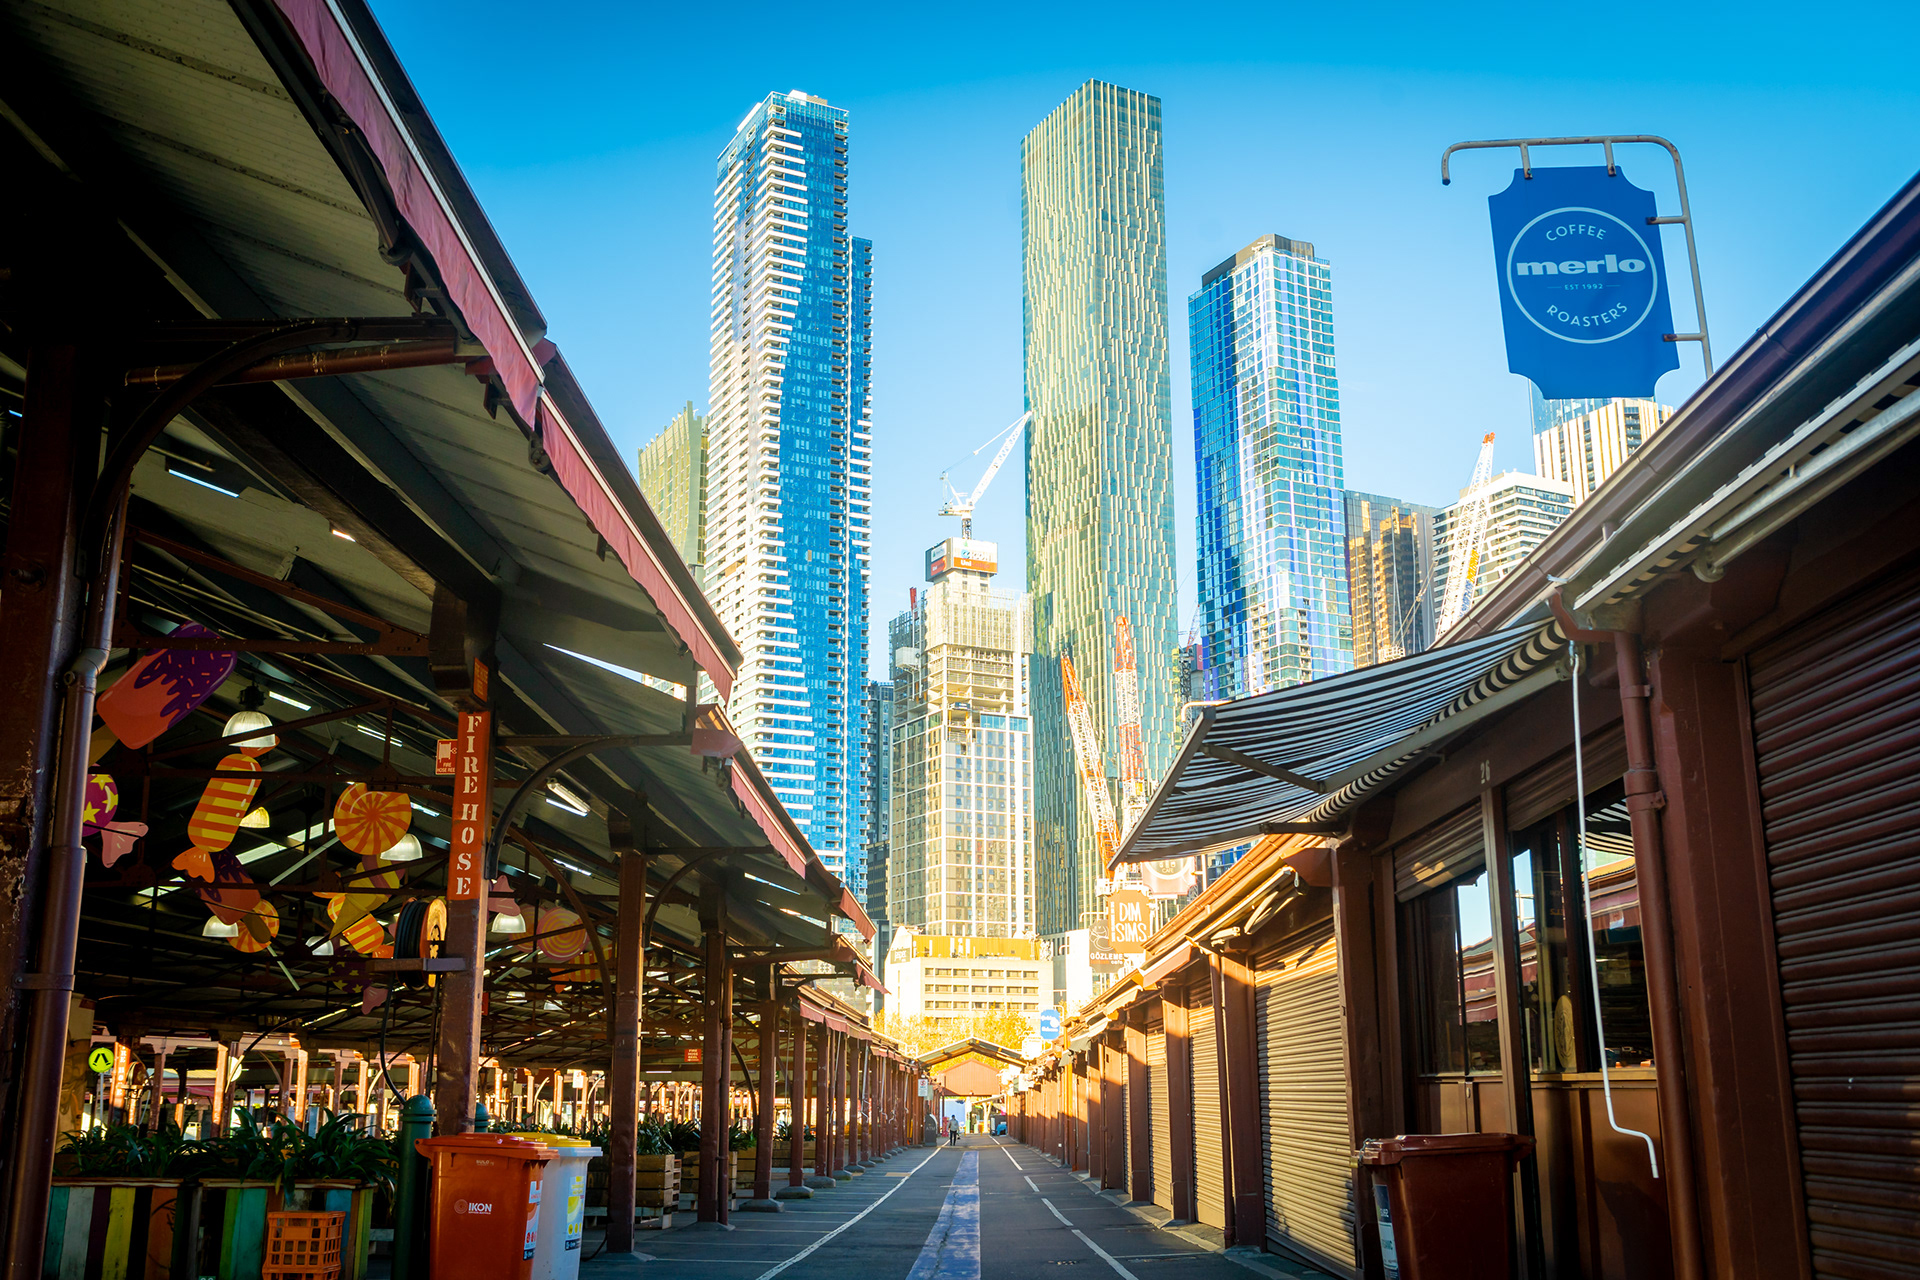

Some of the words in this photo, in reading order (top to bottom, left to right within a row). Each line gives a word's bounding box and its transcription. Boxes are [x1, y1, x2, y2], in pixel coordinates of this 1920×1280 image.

[1546, 224, 1606, 241] COFFEE
[1516, 254, 1646, 276] merlo
[1546, 302, 1628, 327] ROASTERS
[463, 715, 482, 794] FIRE
[1480, 760, 1490, 784] 26
[456, 803, 479, 895] HOSE
[1119, 901, 1142, 922] DIM
[1115, 922, 1148, 942] SIMS
[1090, 951, 1123, 960] GÖZLEME
[468, 1202, 492, 1212] IKON
